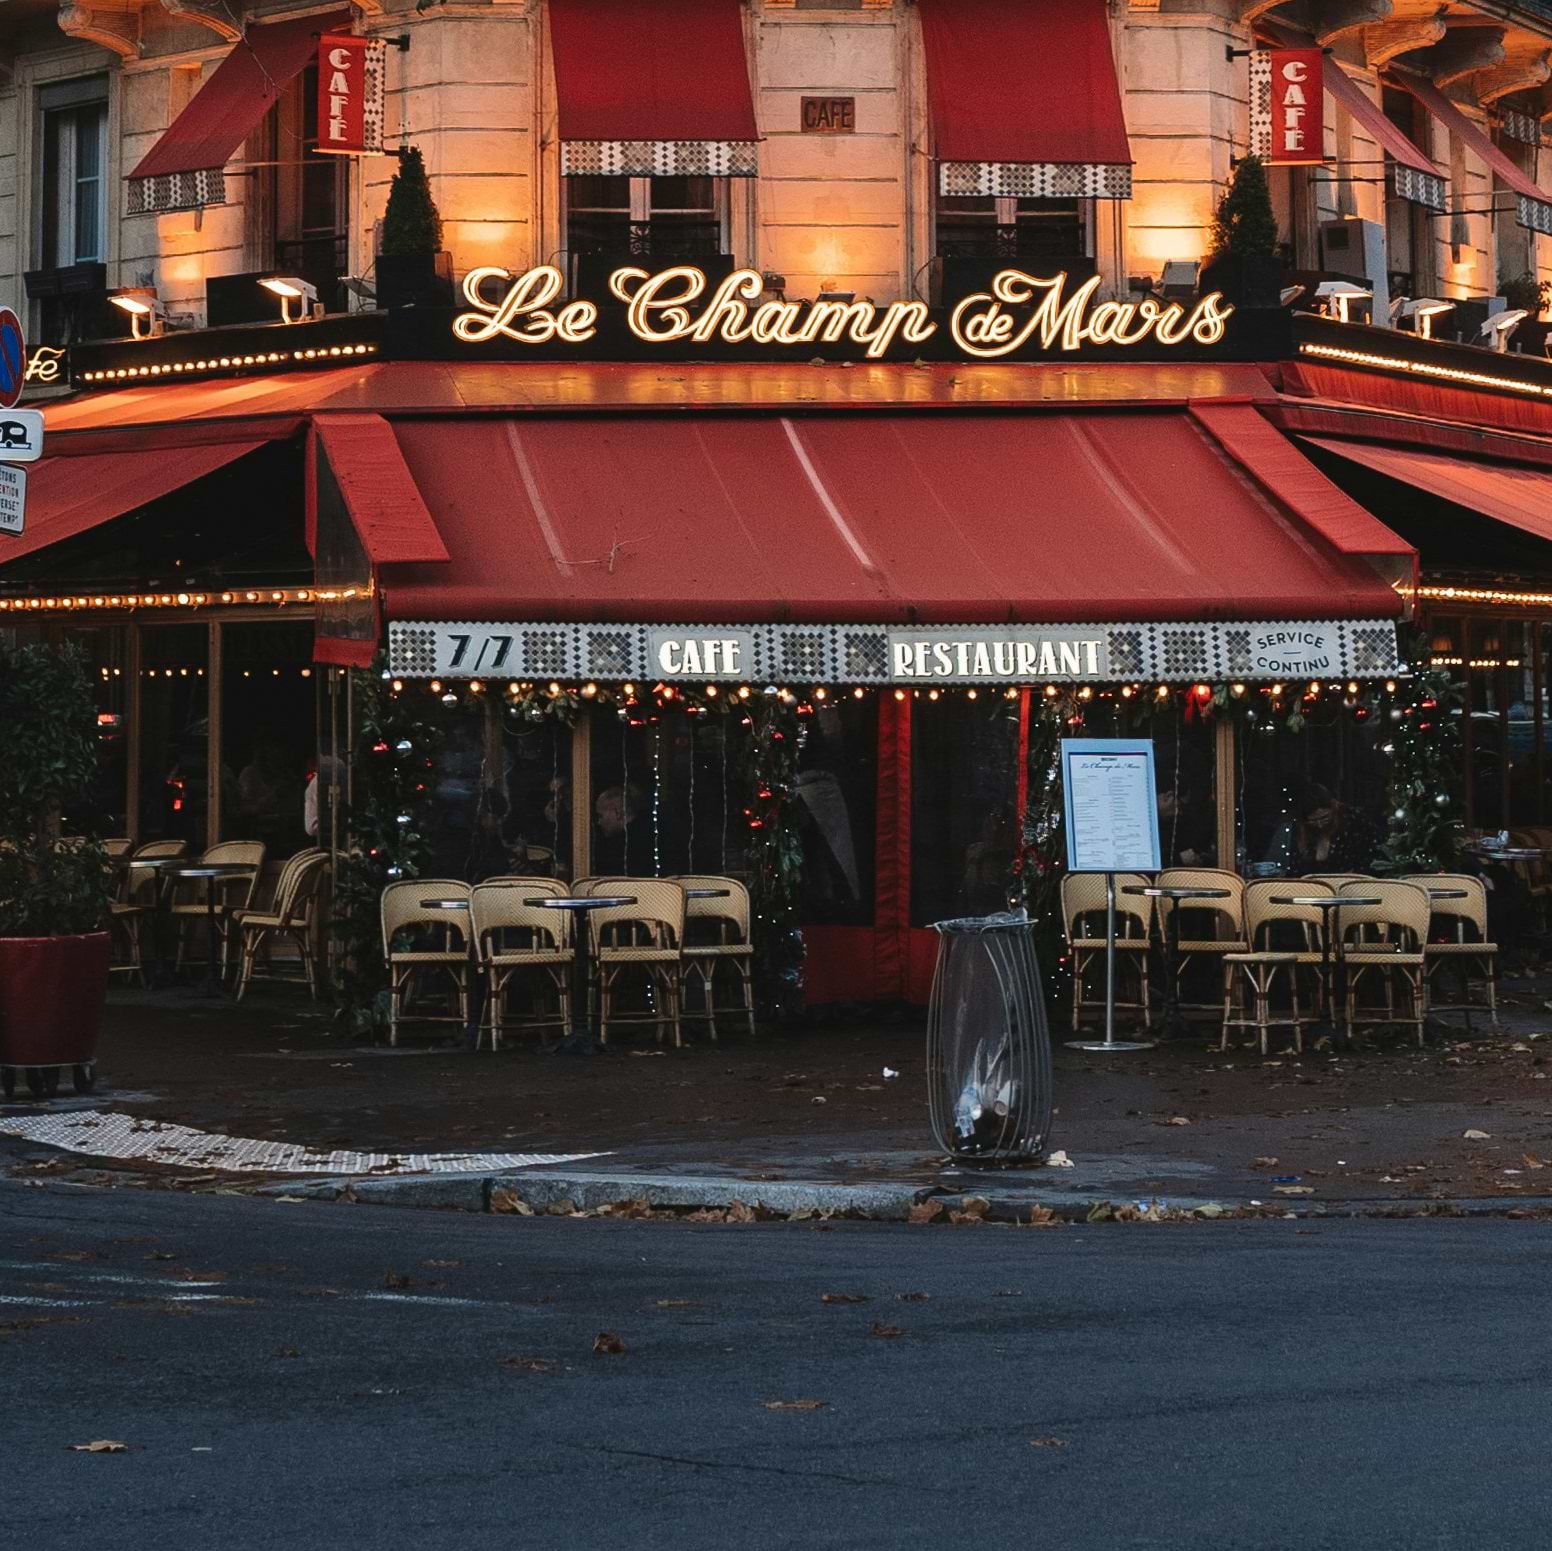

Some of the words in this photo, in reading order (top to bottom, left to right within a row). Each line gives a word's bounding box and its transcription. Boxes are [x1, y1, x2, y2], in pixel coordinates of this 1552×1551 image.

[328, 48, 352, 141] CAFÉ
[1282, 61, 1307, 151] CAFÉ
[453, 265, 598, 344] Le
[609, 265, 938, 358] Champ
[952, 269, 1236, 357] Mars
[965, 302, 1016, 343] de
[447, 634, 513, 672] 7/7
[658, 639, 742, 675] CAFE
[893, 640, 1102, 677] RESTAURANT
[1257, 632, 1325, 650] SERVICE
[1256, 655, 1330, 674] CONTINU
